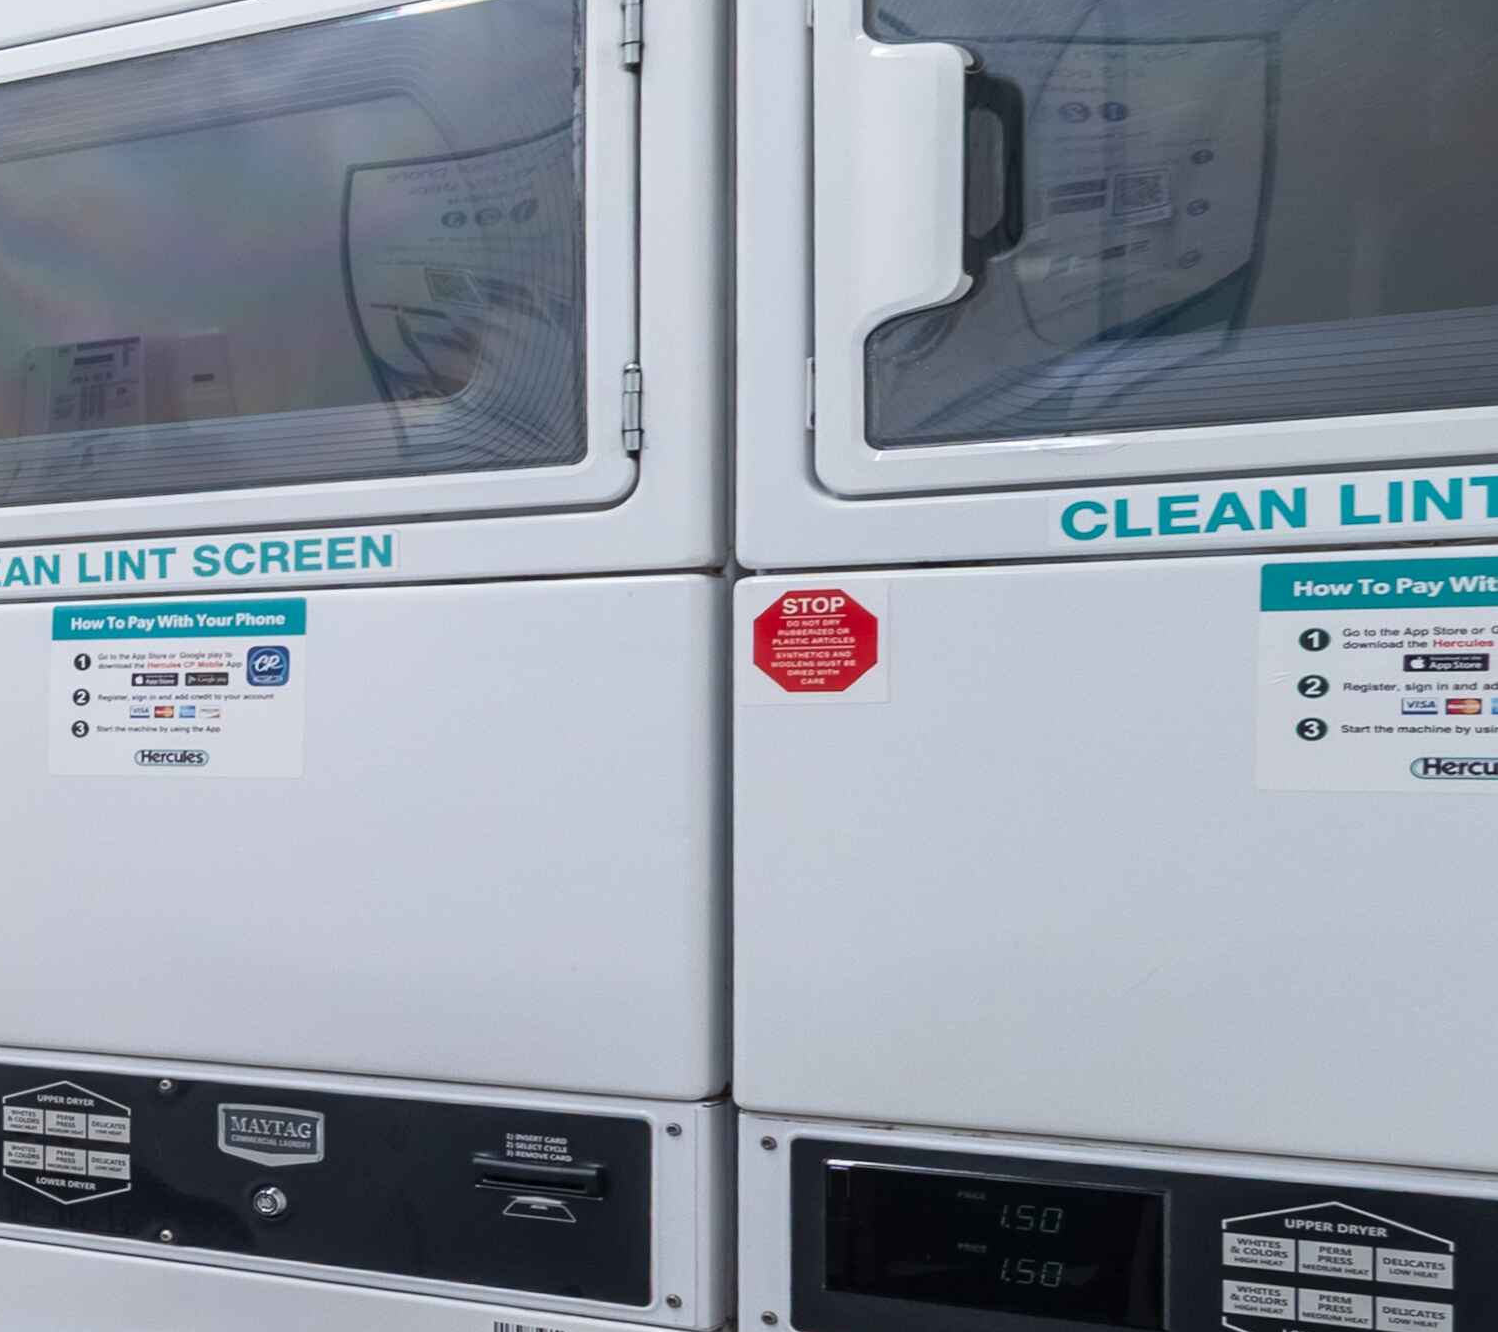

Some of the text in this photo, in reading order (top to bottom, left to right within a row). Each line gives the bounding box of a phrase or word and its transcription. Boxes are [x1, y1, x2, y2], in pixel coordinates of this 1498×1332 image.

[1060, 487, 1307, 541] CLEAN
[78, 547, 177, 583] LINT
[192, 534, 393, 578] SCREEN
[1293, 581, 1354, 597] How
[1357, 579, 1390, 595] To
[1396, 578, 1444, 597] Pay
[782, 597, 845, 614] STOP
[70, 613, 286, 631] How To Pay With Your Phone
[141, 750, 204, 764] Hercules
[37, 1093, 94, 1107] UPPER DRYER
[230, 1117, 312, 1140] MAYTAG
[36, 1176, 96, 1191] LOWER DRYER
[1000, 1204, 1064, 1233] 1.50
[1284, 1218, 1388, 1238] UPPER DRYER
[1000, 1258, 1064, 1288] 1.50
